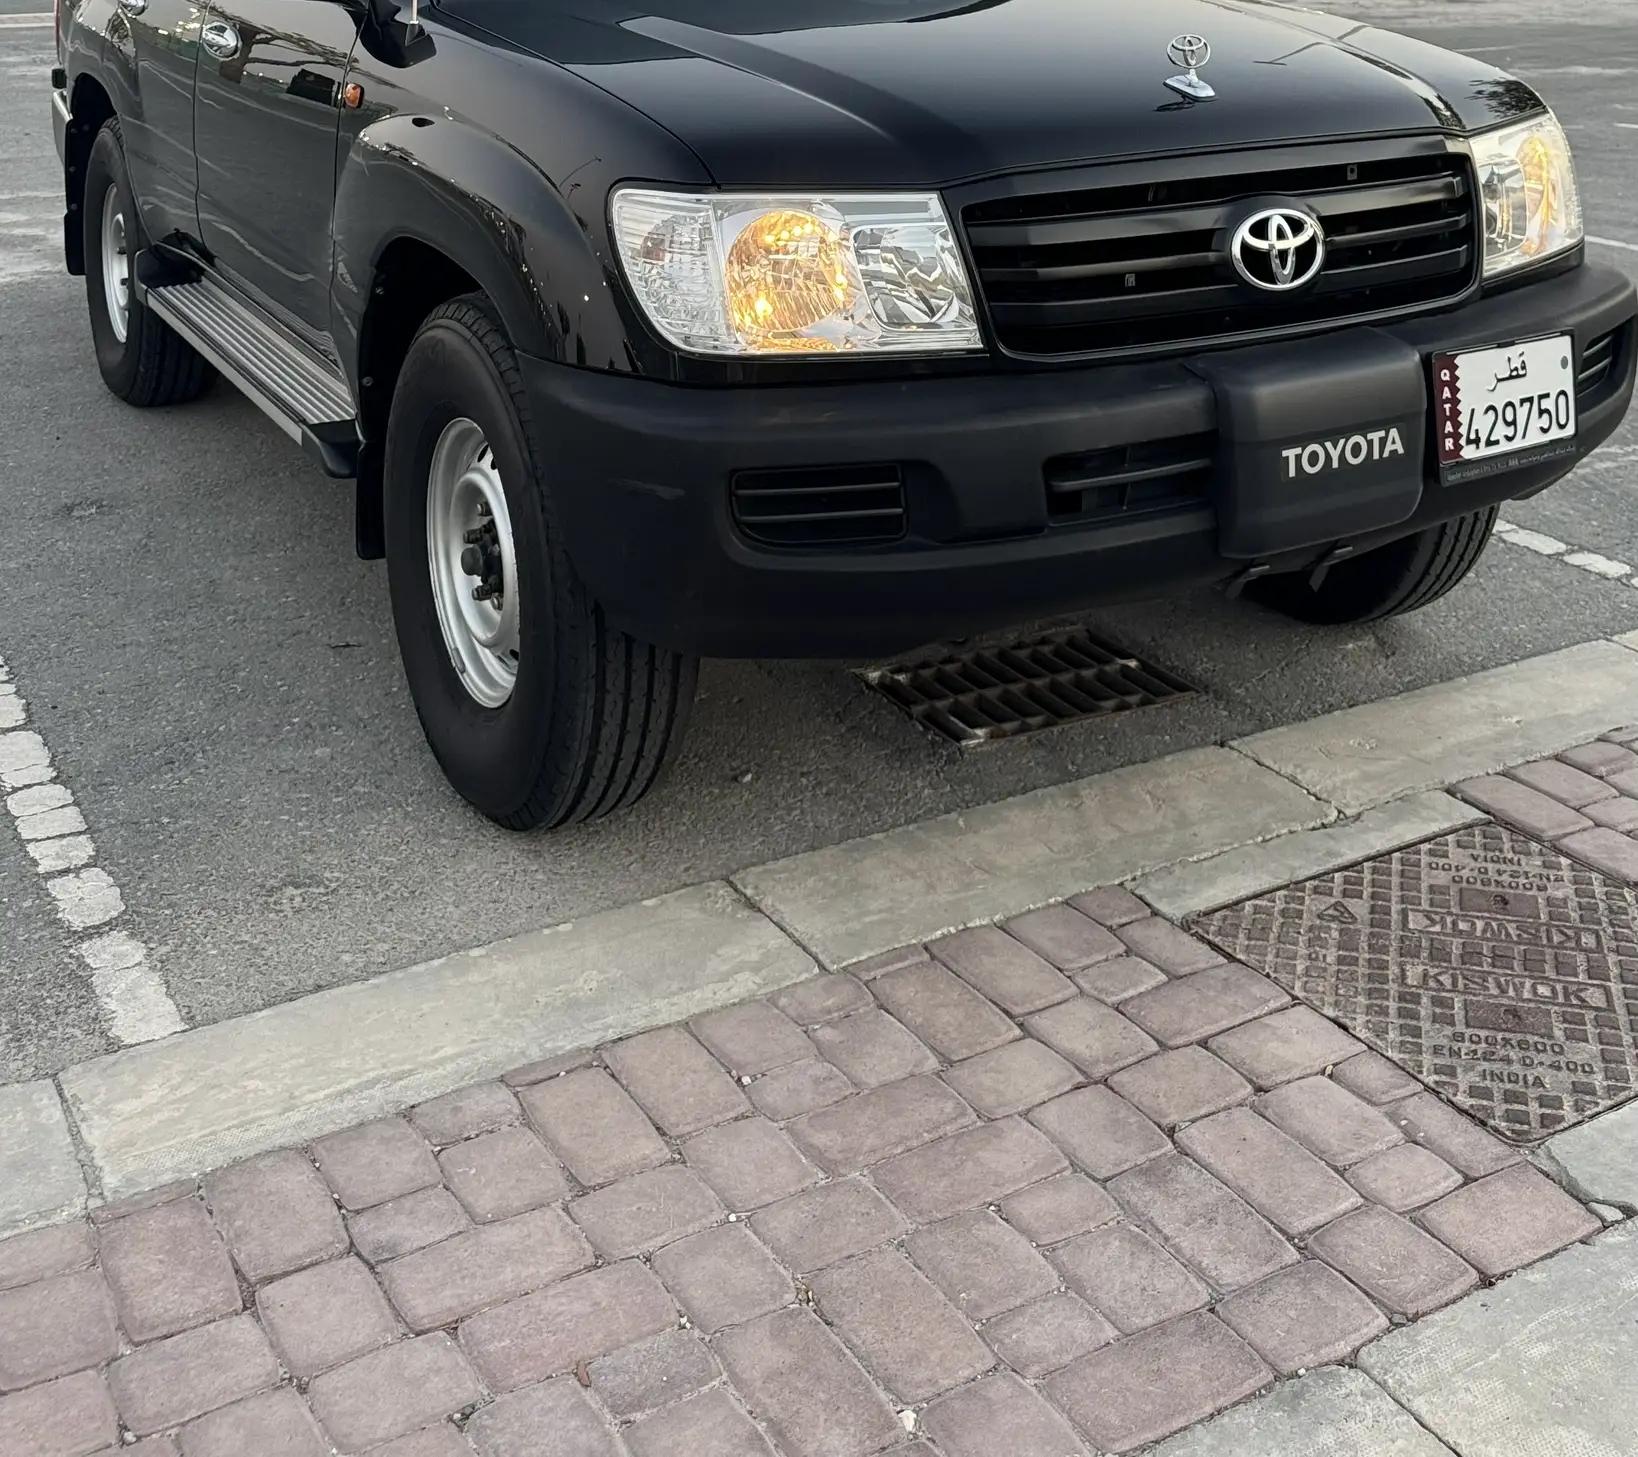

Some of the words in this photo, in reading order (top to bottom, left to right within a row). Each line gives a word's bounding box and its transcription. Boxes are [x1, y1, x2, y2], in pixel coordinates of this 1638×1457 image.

[1486, 351, 1527, 392] قطر
[1440, 369, 1454, 451] QATAR
[1465, 389, 1569, 450] 429750
[1282, 428, 1404, 478] TOYOTA
[1470, 853, 1522, 867] INDIA
[1423, 968, 1592, 1007] KISWOK
[1481, 1069, 1548, 1089] INDIA
